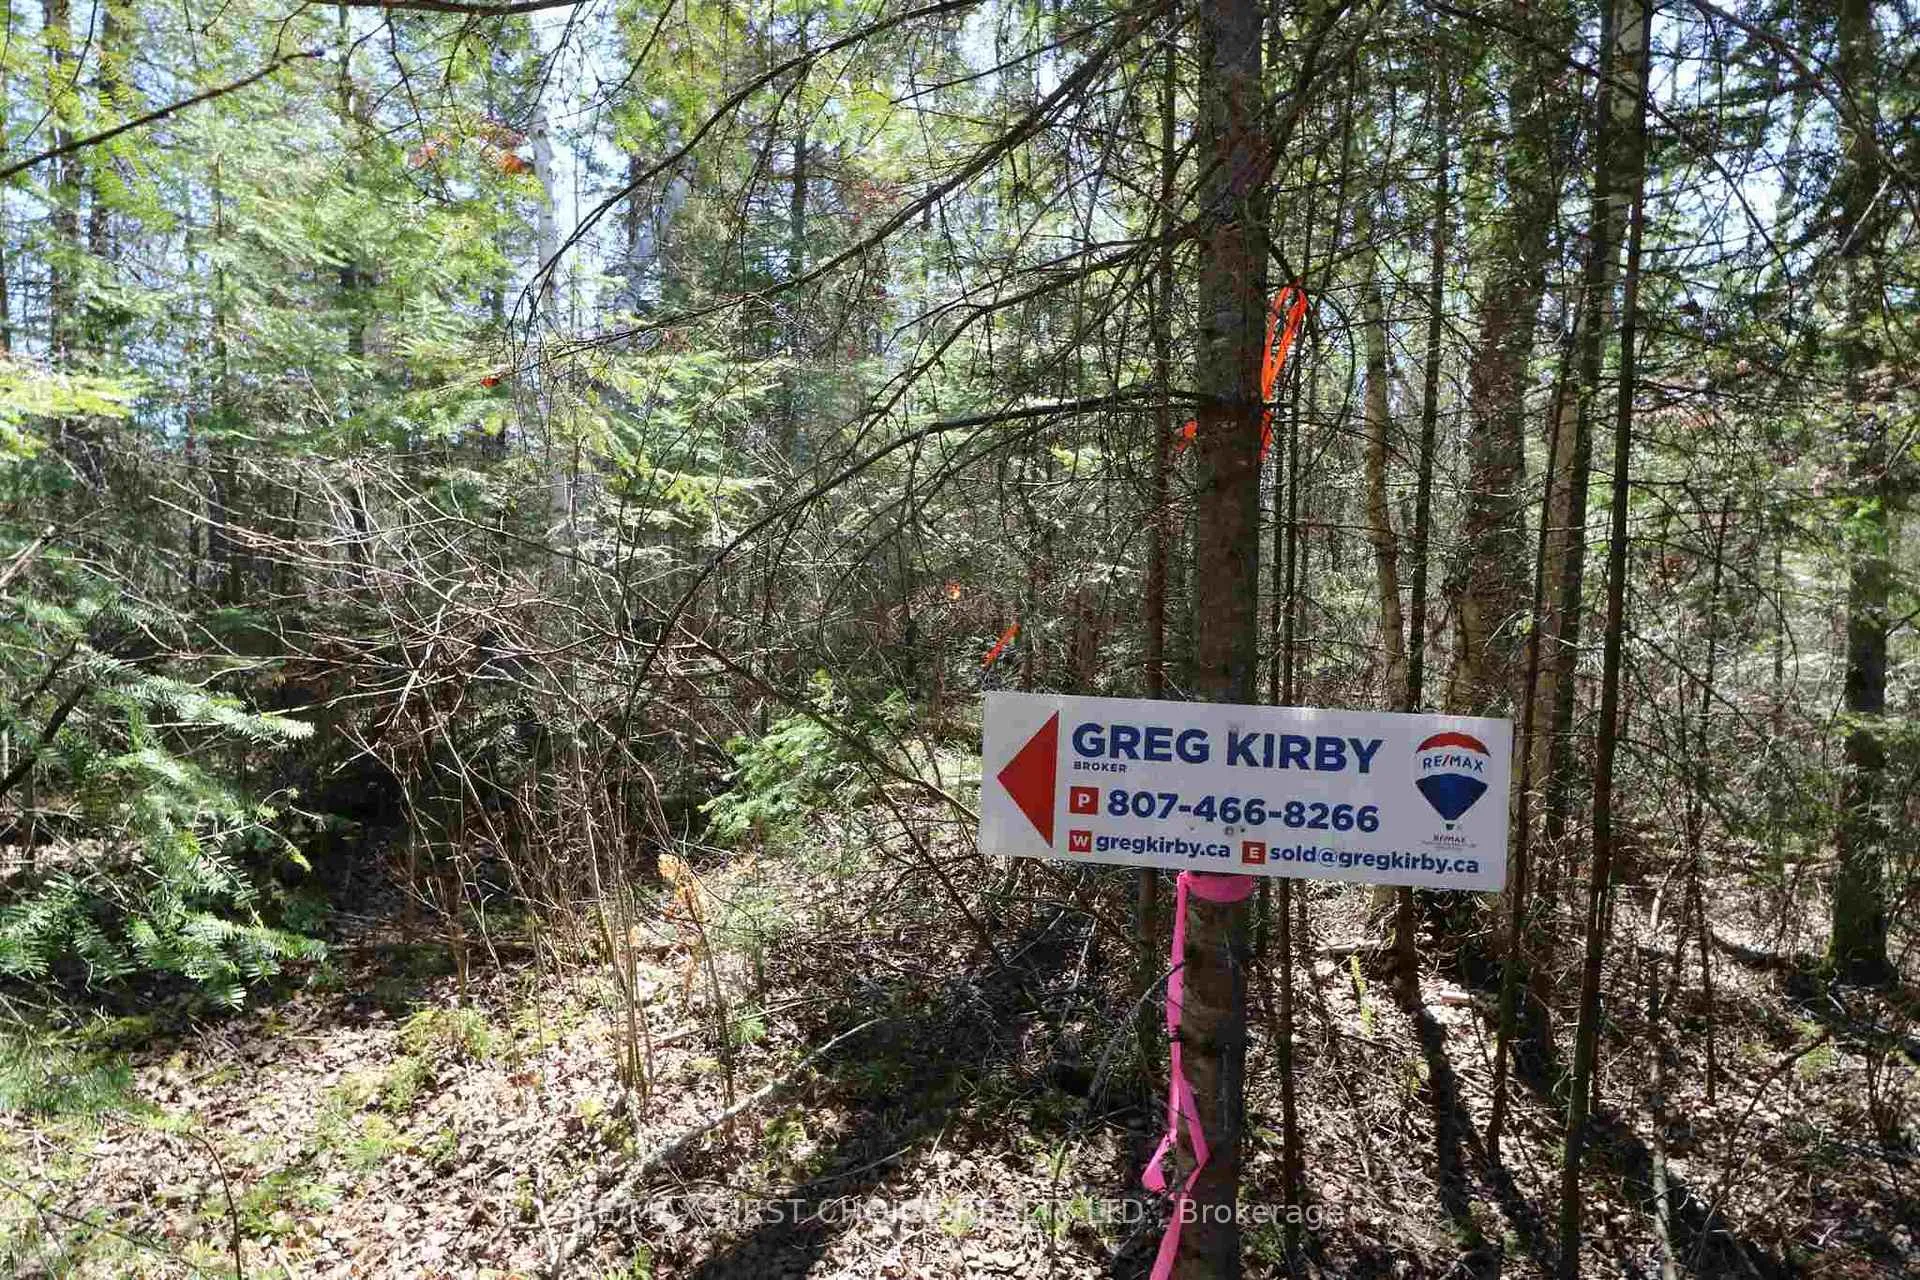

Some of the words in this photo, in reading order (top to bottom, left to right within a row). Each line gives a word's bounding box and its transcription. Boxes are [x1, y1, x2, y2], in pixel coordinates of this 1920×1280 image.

[1072, 722, 1210, 764] GREG
[1226, 731, 1383, 773] KIRBY
[1073, 760, 1128, 773] BROKER
[1422, 754, 1484, 773] RE/MAX
[1079, 793, 1091, 808] P
[1107, 789, 1380, 833] 807-466-8266
[1072, 835, 1090, 847] W
[1096, 834, 1231, 858] gregkirby.ca
[1248, 846, 1260, 858] E
[1269, 846, 1479, 874] sold@gregkirby.ca
